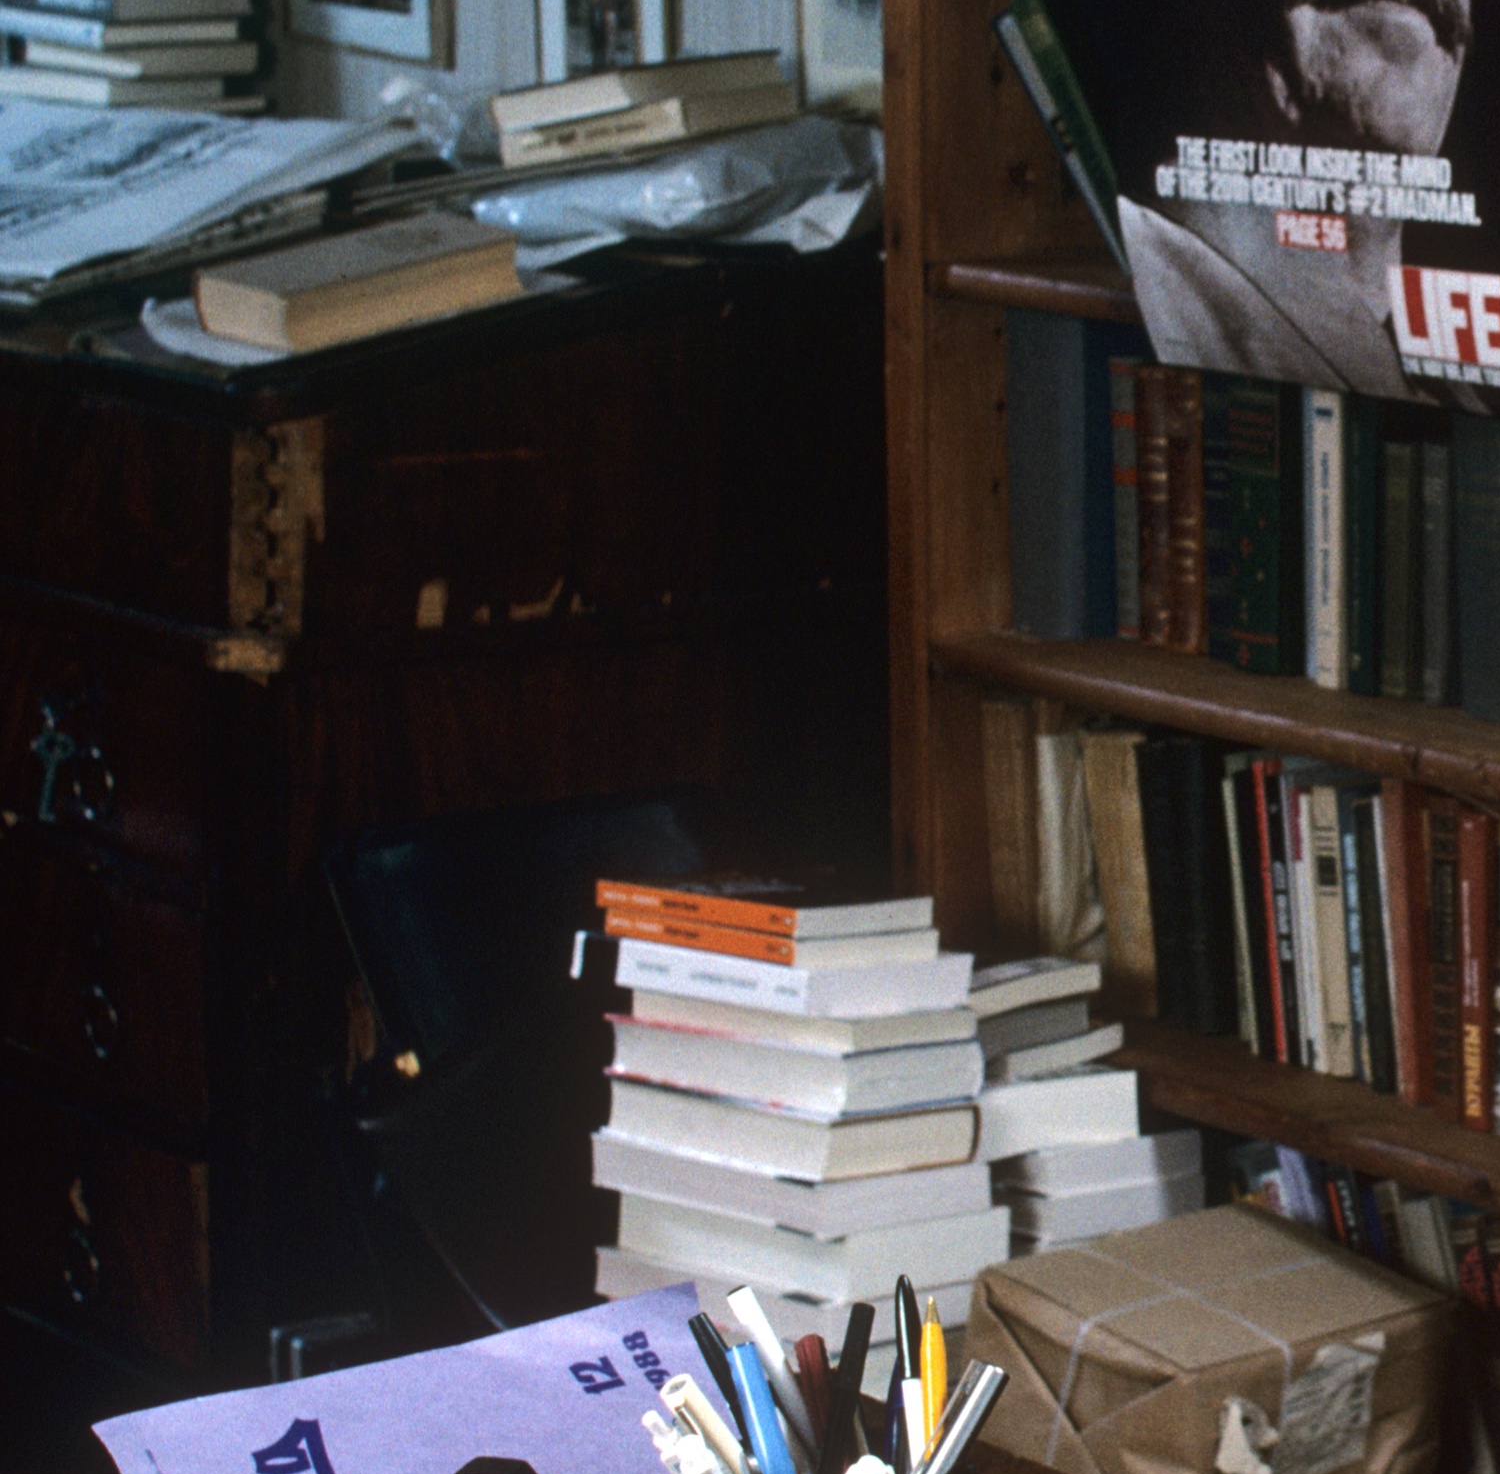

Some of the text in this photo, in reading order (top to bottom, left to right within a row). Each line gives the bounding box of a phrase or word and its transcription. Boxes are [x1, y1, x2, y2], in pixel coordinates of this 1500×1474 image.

[1175, 135, 1452, 190] THE FIRST LOOK INSIDE THE MIND
[1155, 164, 1178, 198] OF
[1178, 167, 1209, 201] THE
[1251, 174, 1346, 214] CENTURY'S
[1385, 186, 1483, 226] MADMAN.
[1276, 211, 1321, 248] PAGE
[569, 1355, 626, 1394] 12
